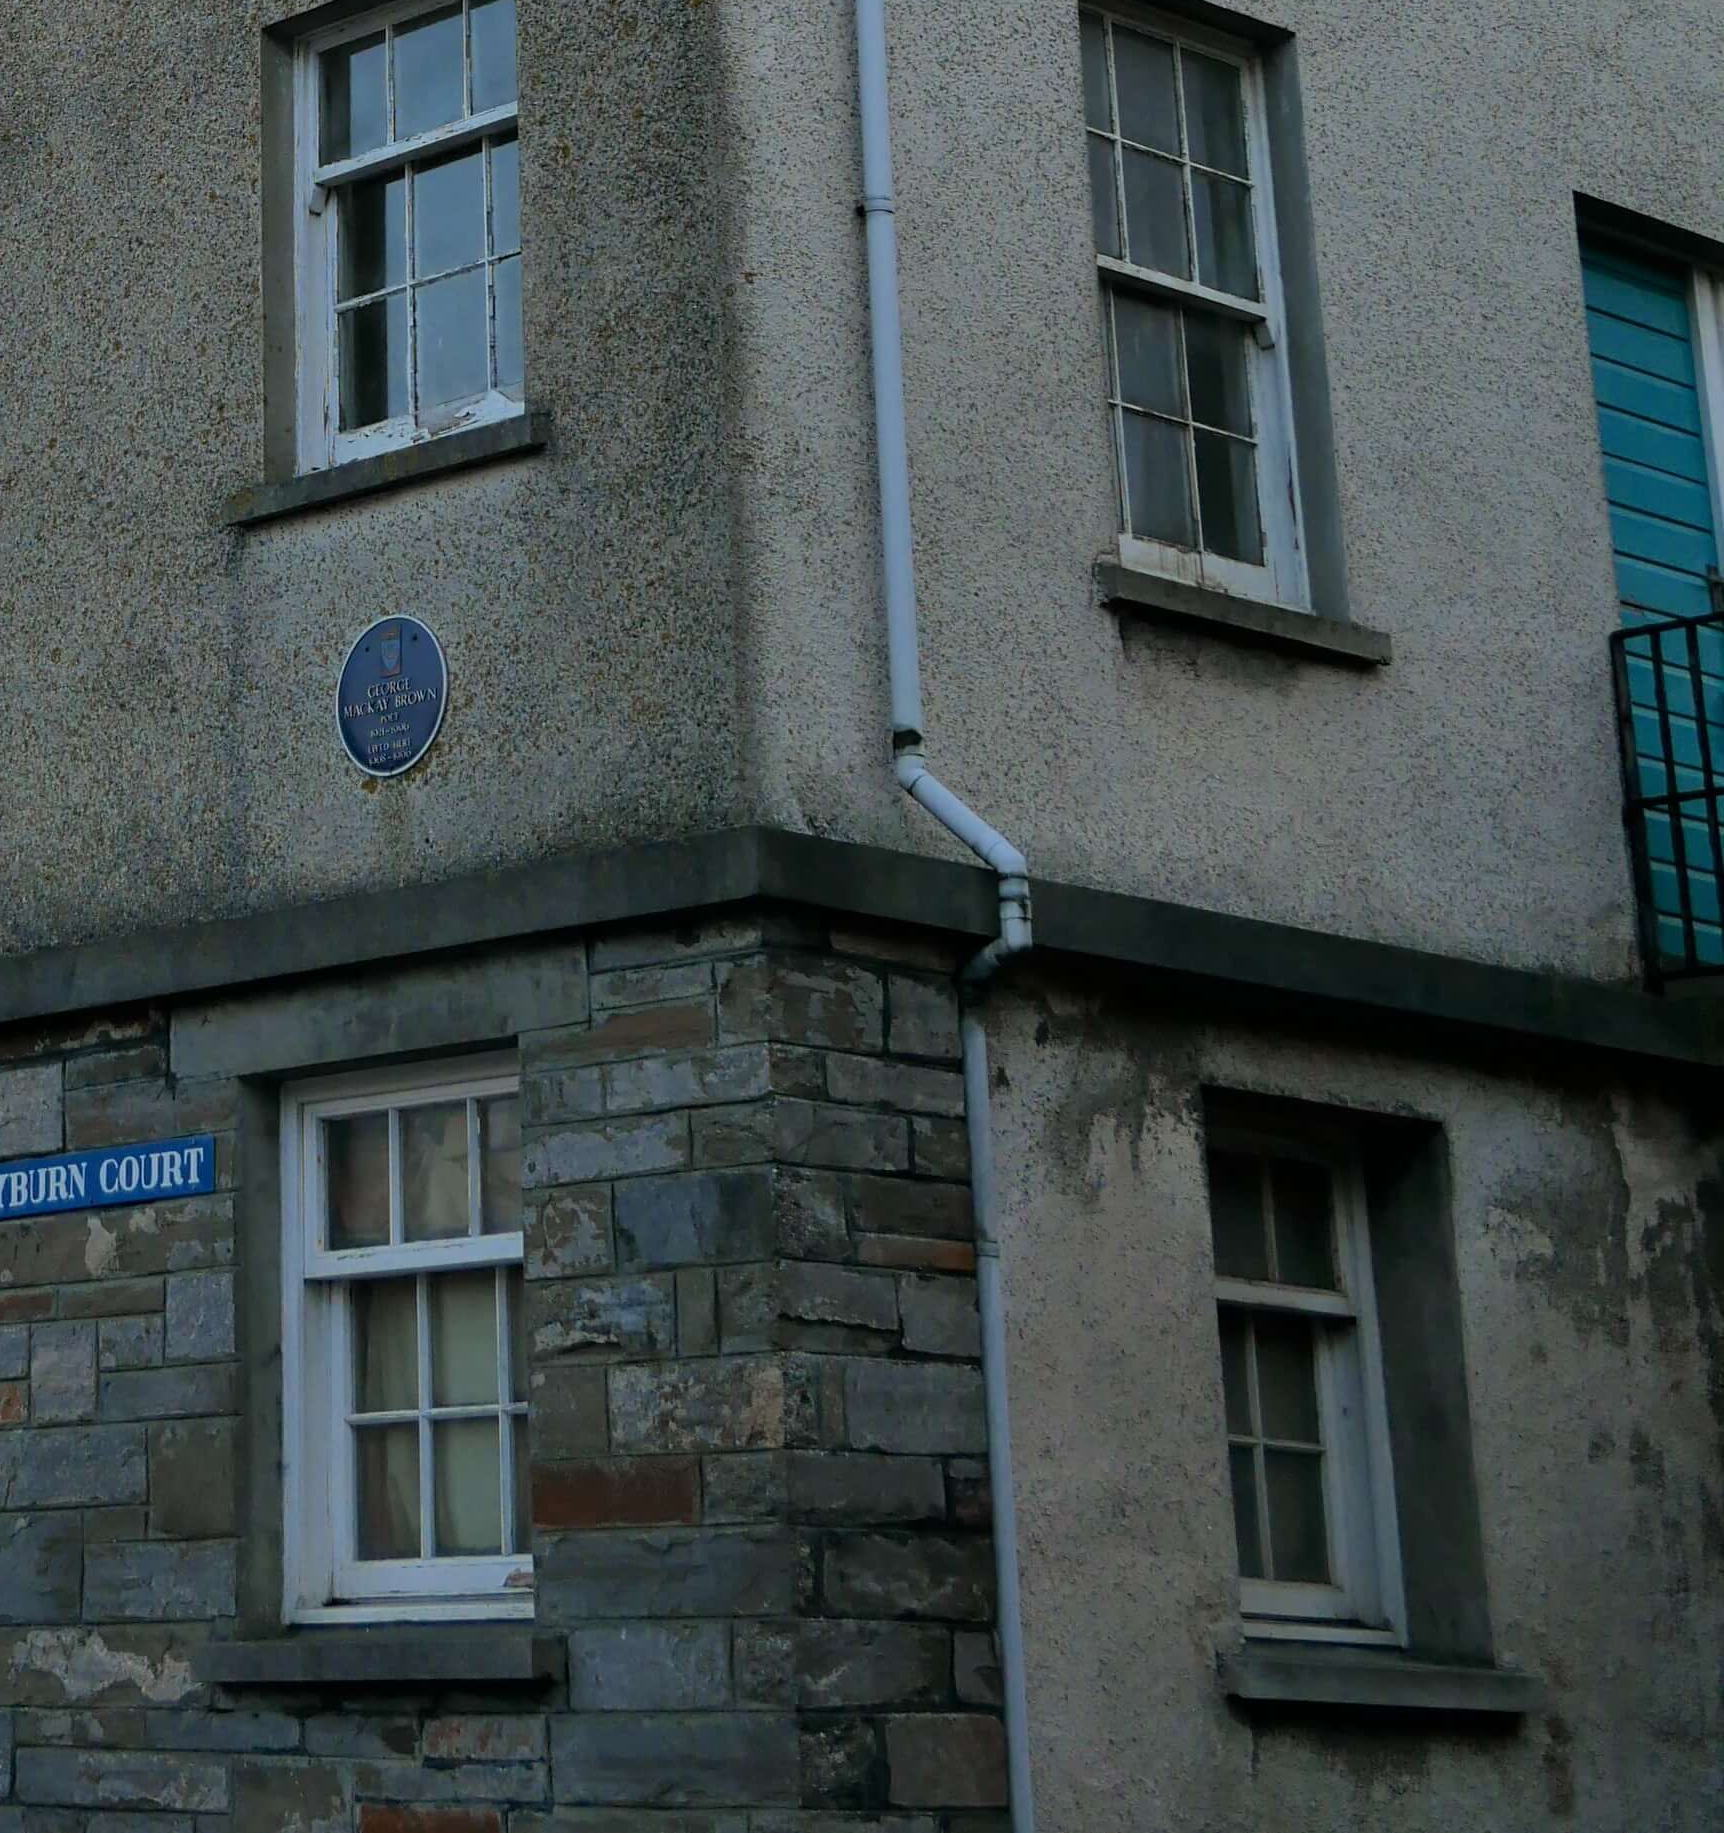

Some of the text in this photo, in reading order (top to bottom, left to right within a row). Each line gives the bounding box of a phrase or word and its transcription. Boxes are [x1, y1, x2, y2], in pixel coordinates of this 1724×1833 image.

[344, 687, 437, 719] MACKAY BROWN
[367, 677, 411, 699] GEORGE
[99, 1147, 204, 1194] COURT
